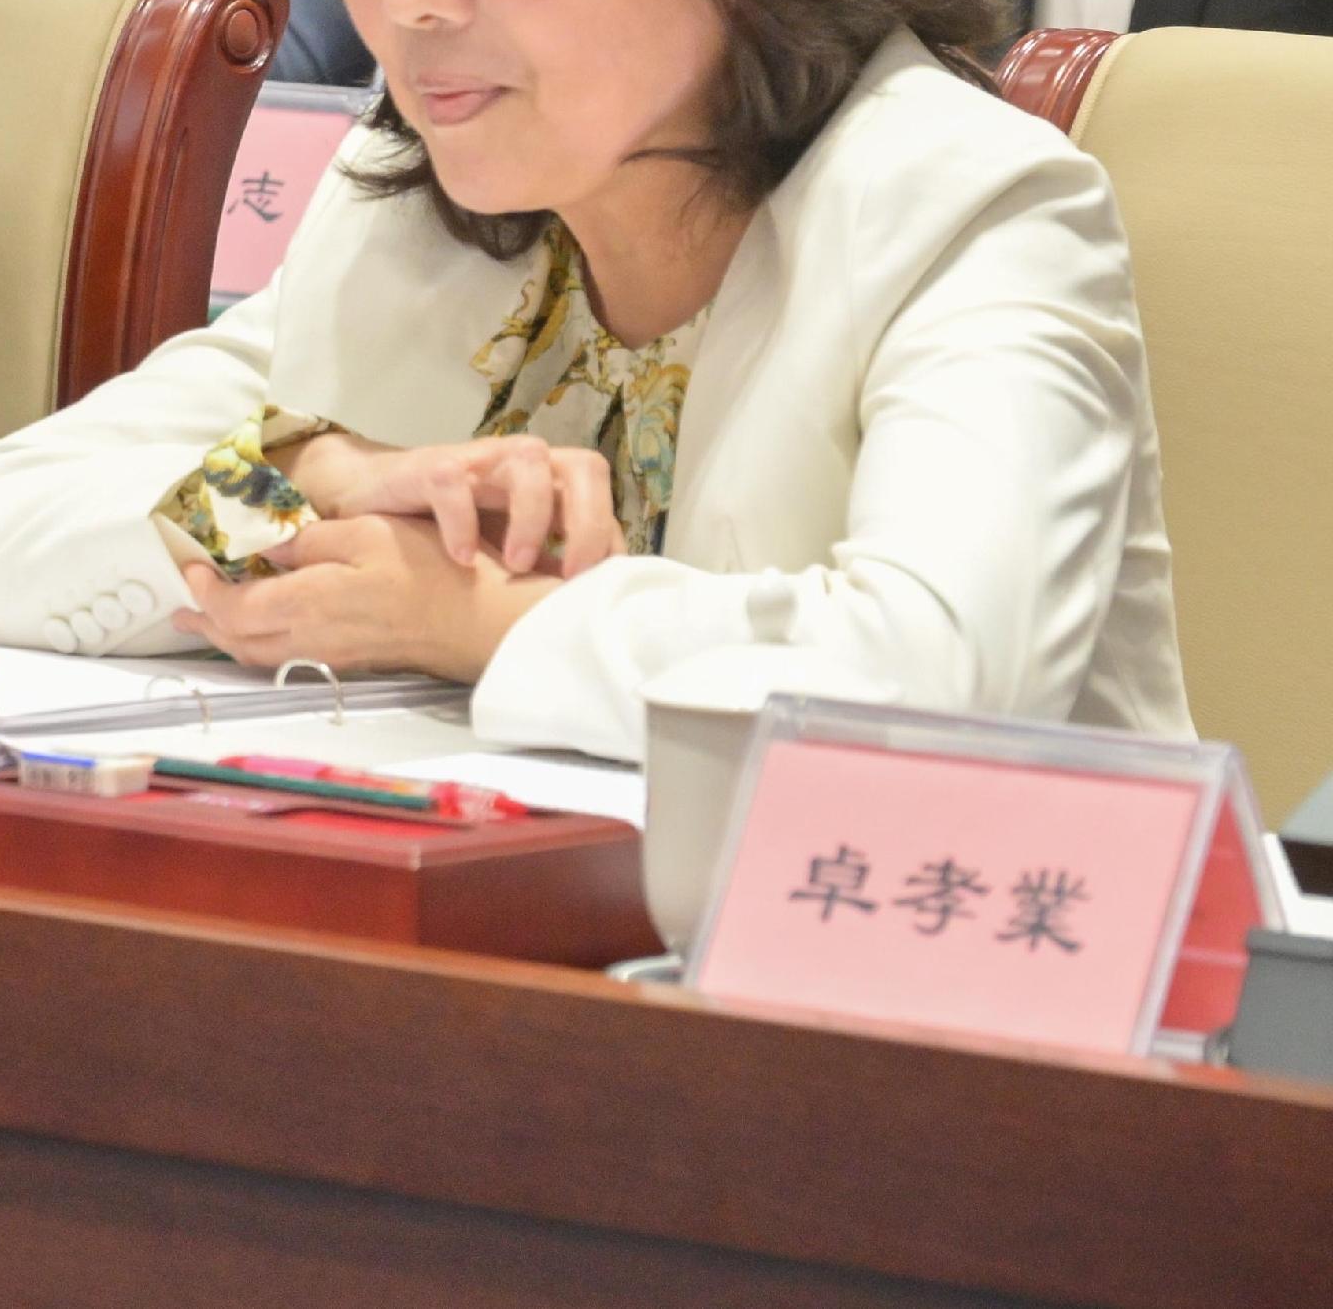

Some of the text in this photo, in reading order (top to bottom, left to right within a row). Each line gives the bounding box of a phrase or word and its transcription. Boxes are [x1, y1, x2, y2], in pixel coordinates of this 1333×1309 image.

[226, 169, 285, 223] 志
[789, 843, 1091, 953] 卓孝業
